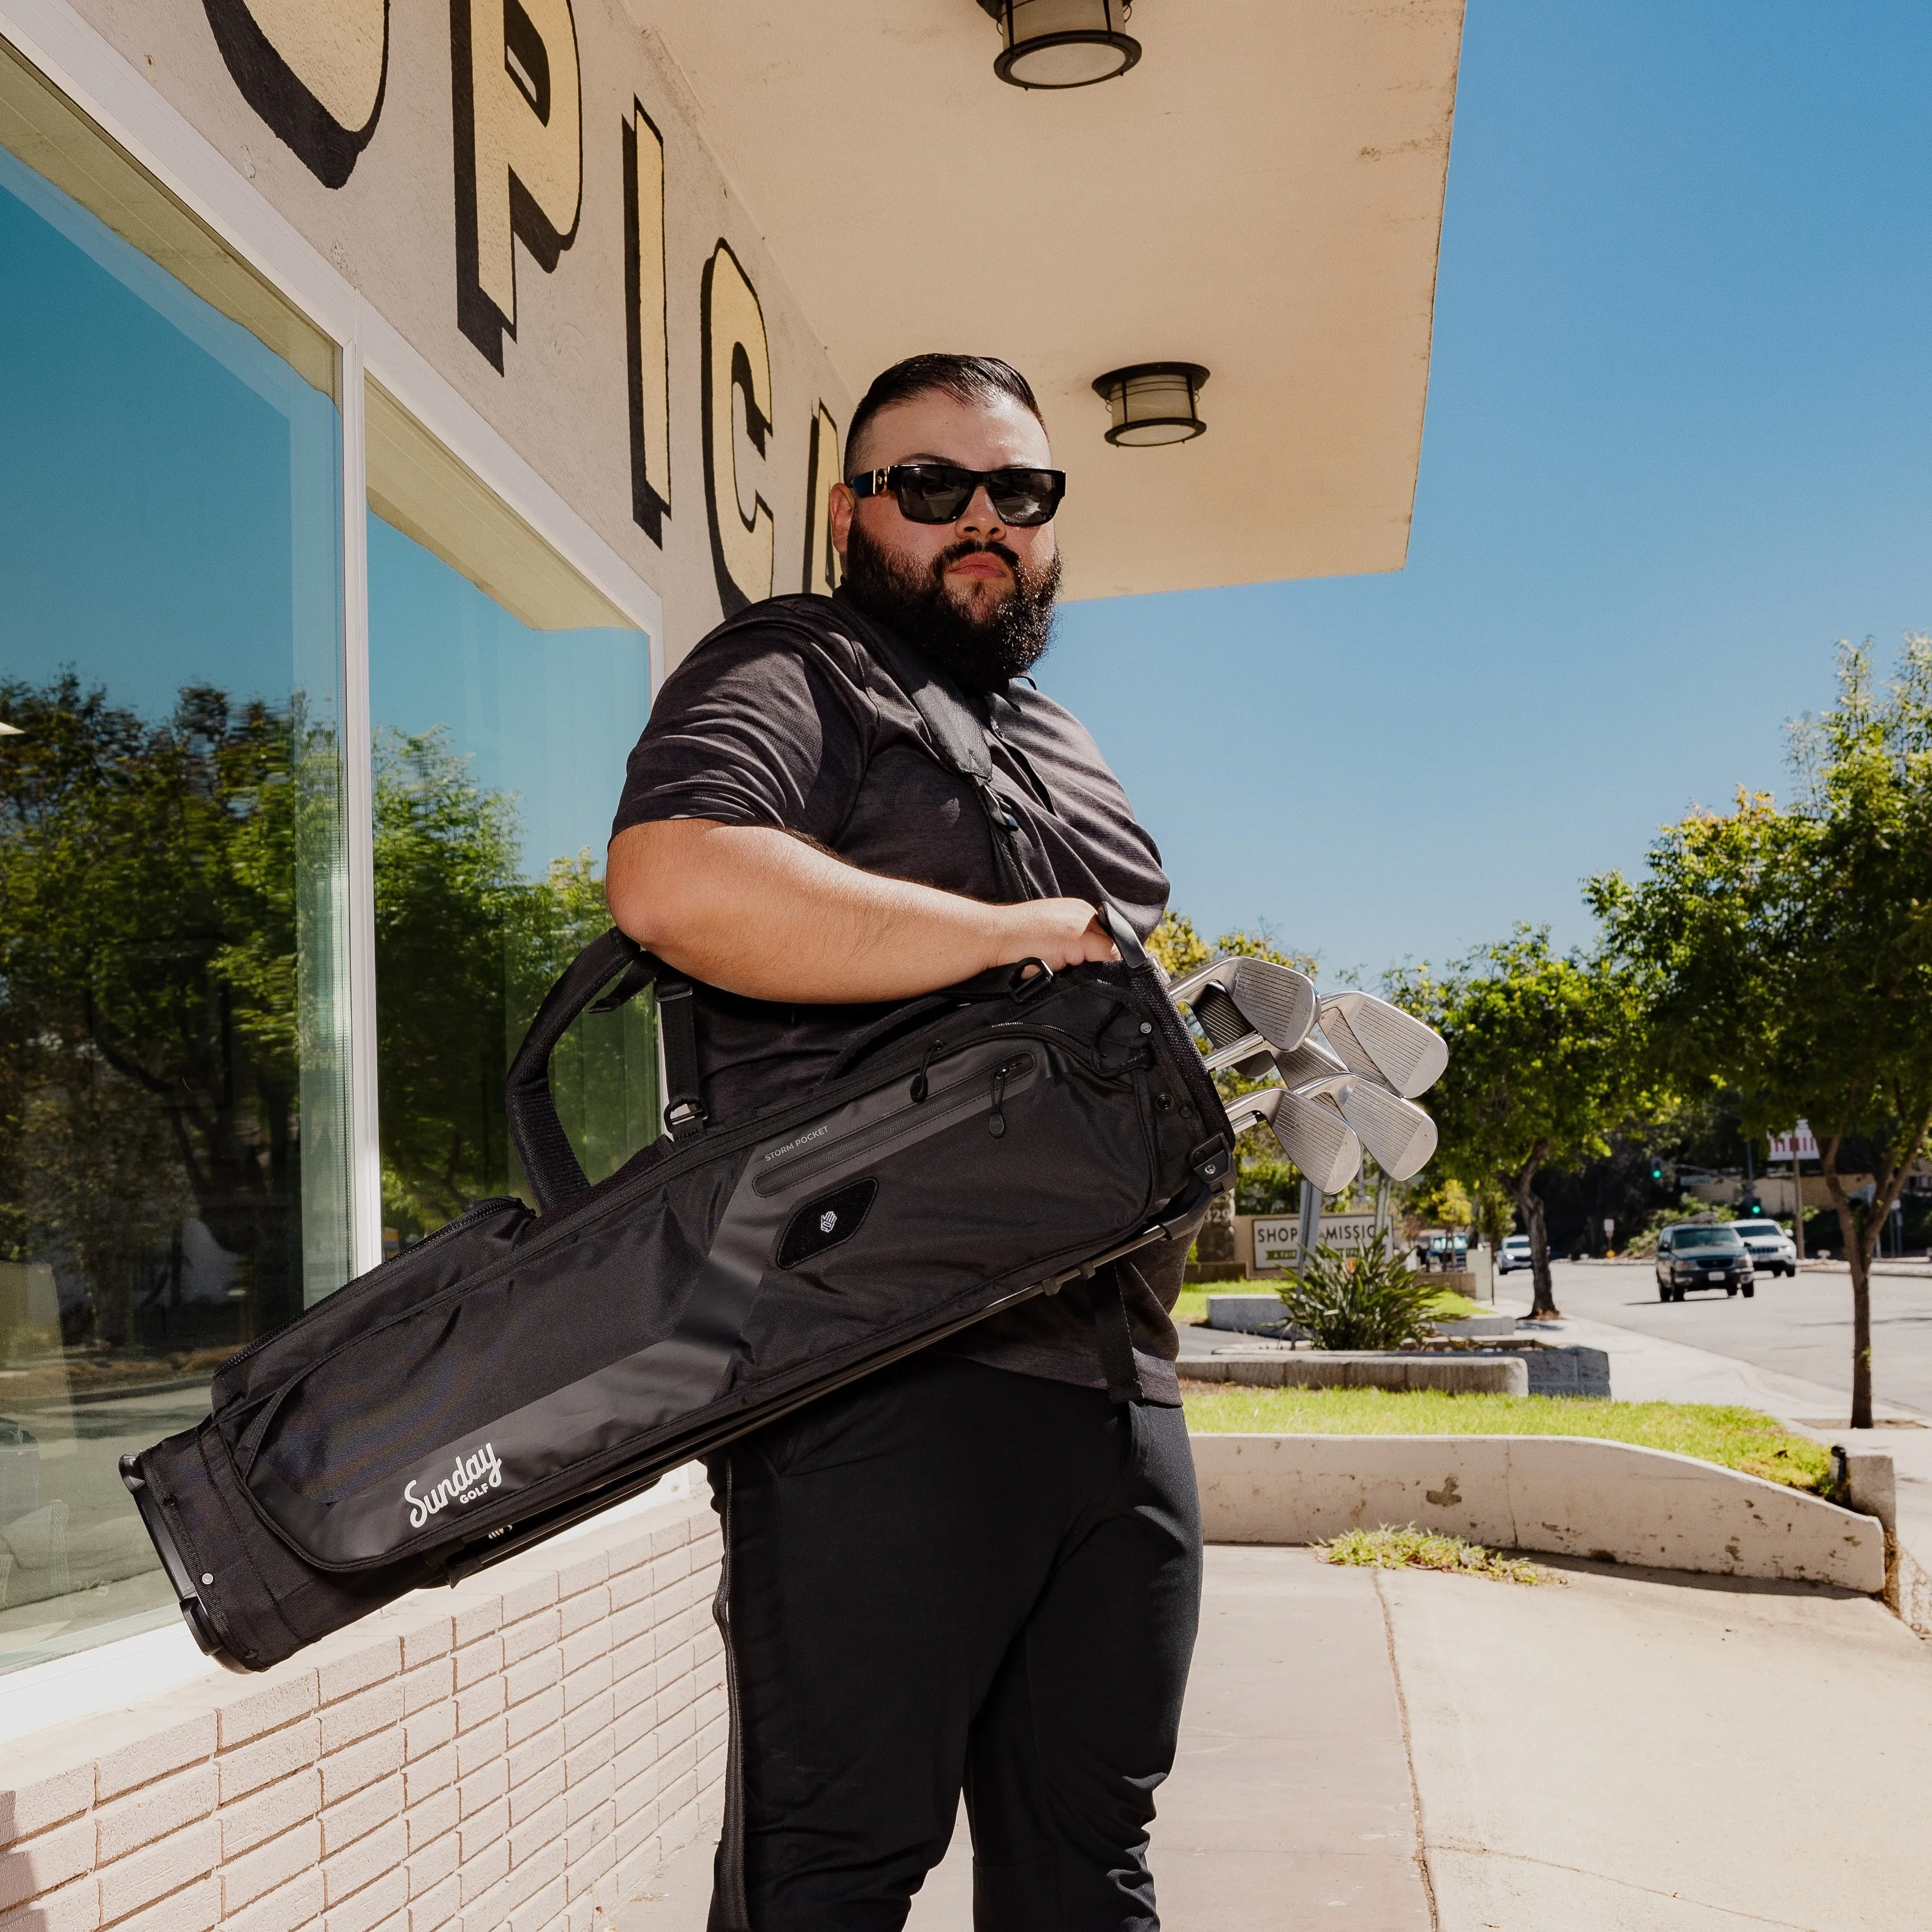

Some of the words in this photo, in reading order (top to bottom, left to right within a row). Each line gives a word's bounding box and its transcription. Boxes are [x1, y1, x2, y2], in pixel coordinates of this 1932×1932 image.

[765, 1143, 795, 1161] STORM
[795, 1125, 828, 1147] POCKET
[1258, 1227, 1297, 1243] SHOP
[404, 1442, 502, 1528] Sunday
[459, 1483, 489, 1504] GOLF
